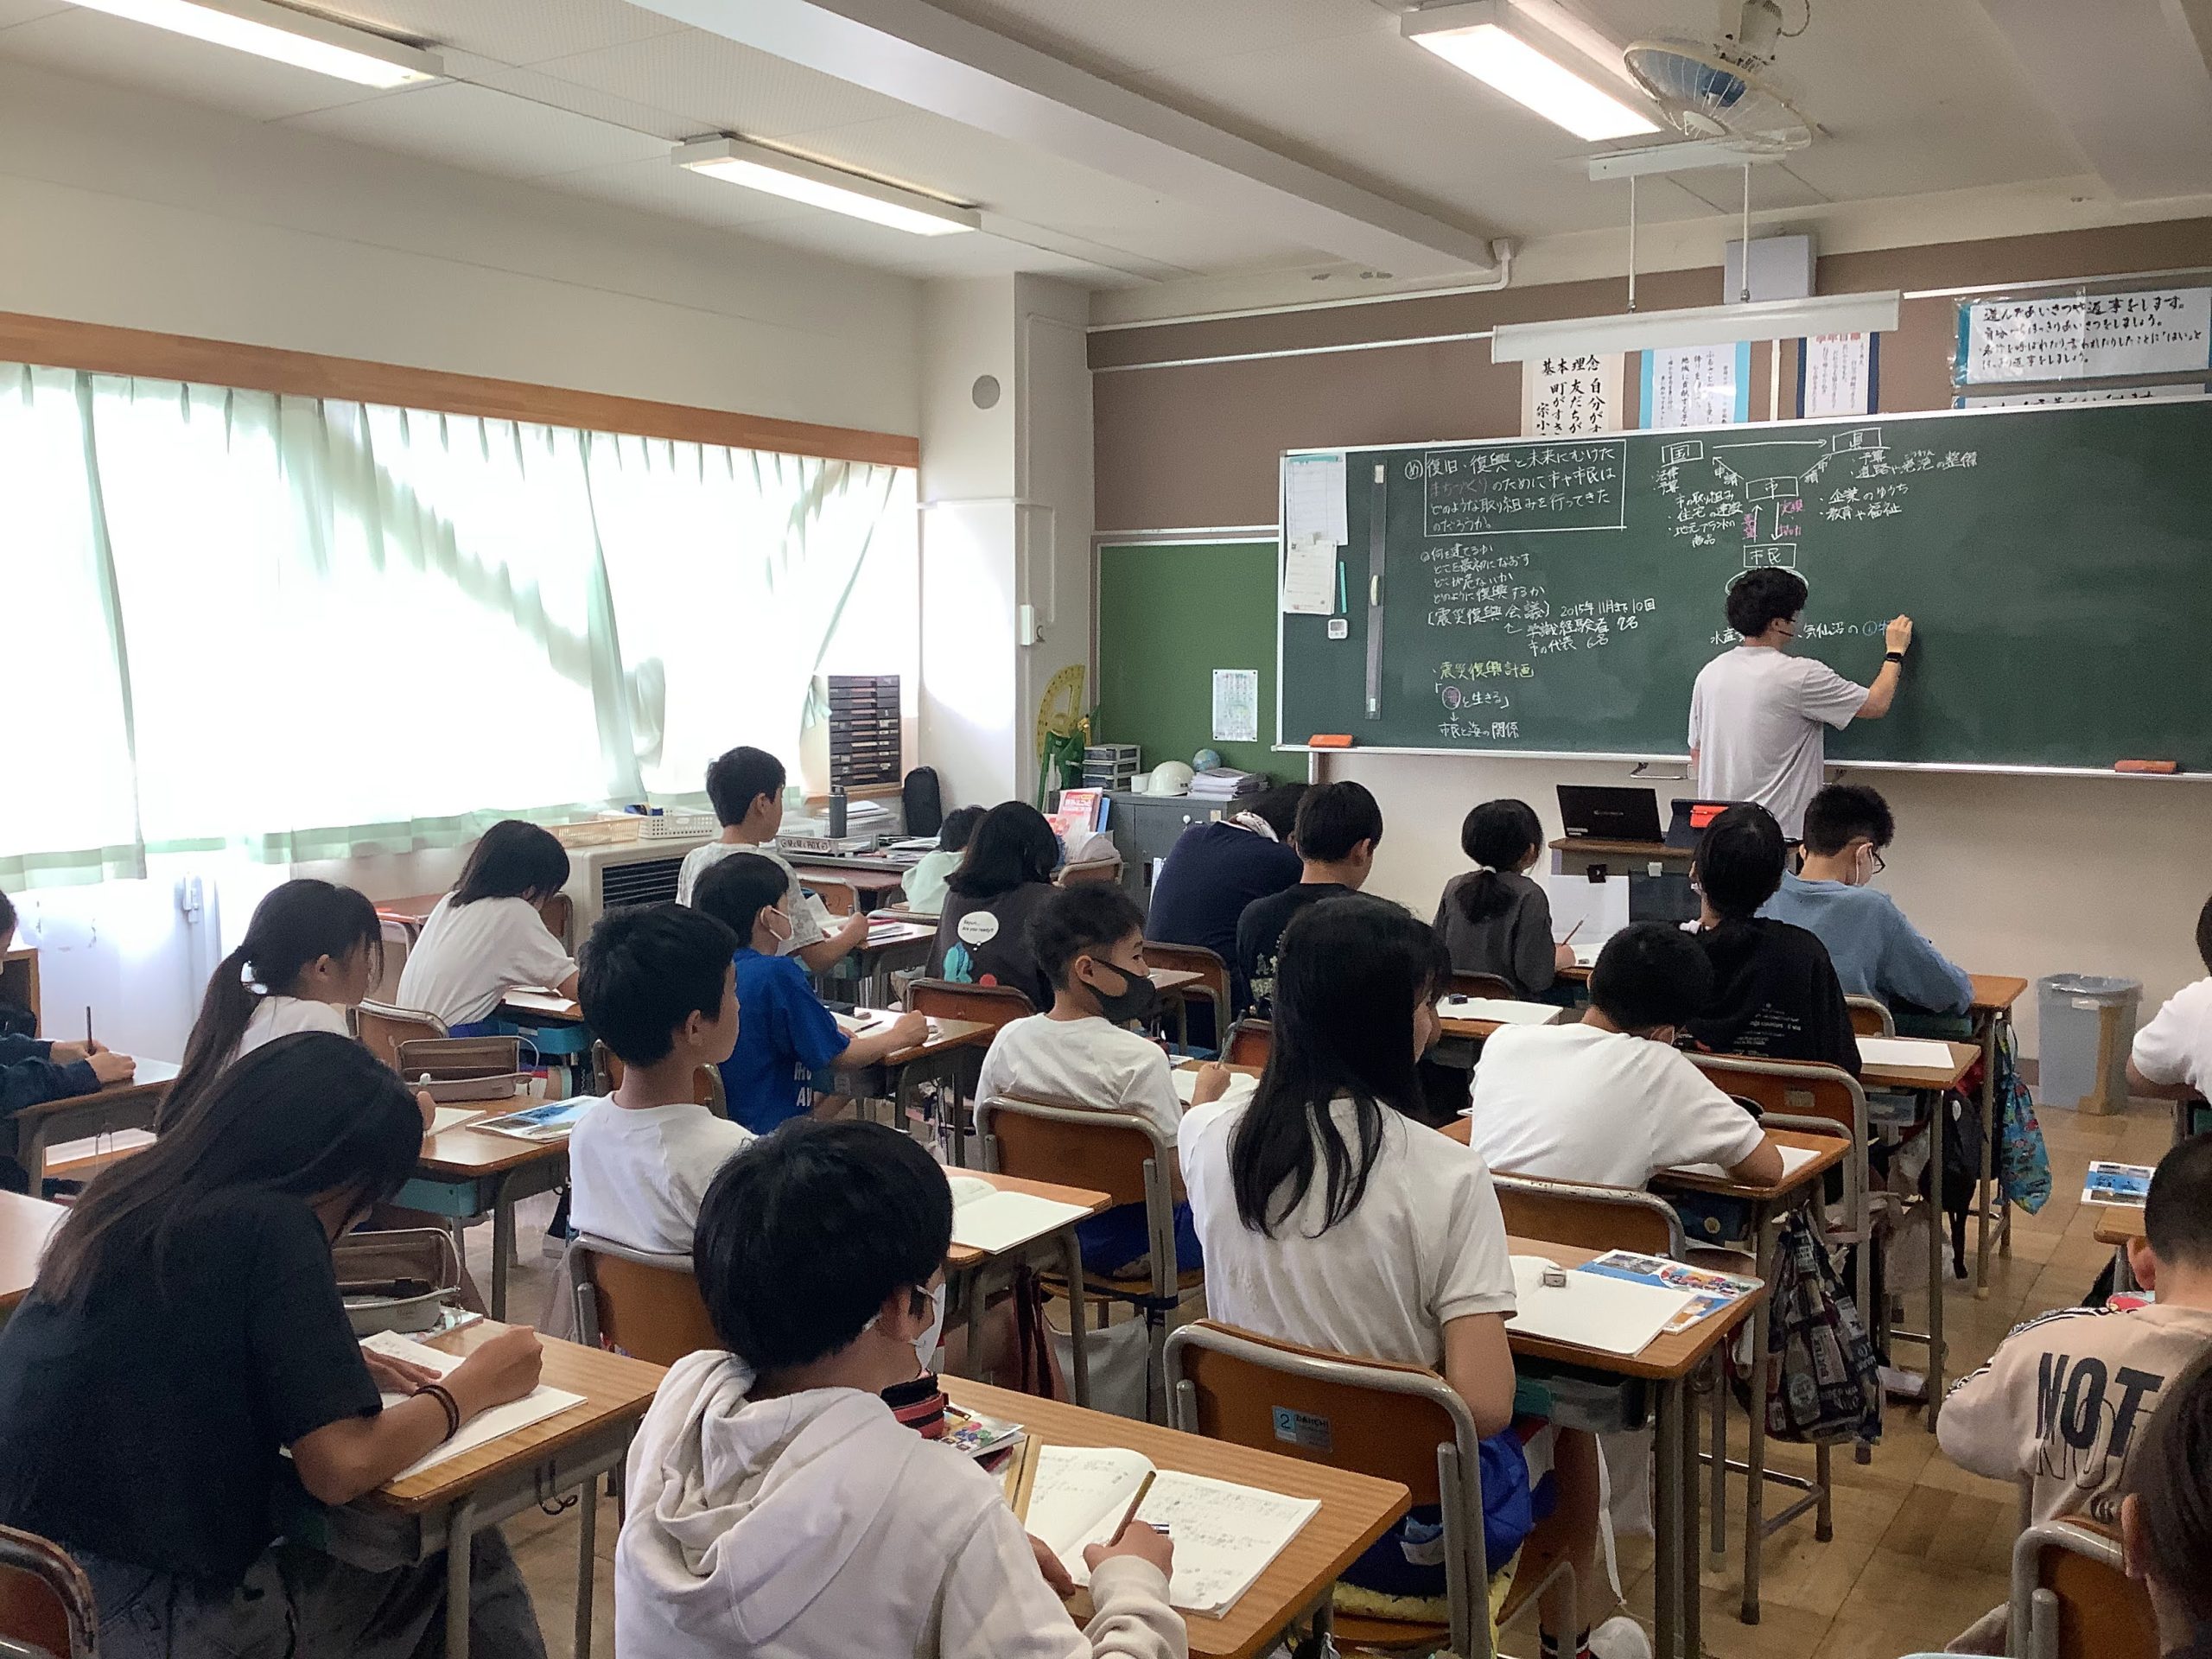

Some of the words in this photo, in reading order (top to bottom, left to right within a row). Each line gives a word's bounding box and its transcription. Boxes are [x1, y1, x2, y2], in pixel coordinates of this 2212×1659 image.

[1542, 354, 1600, 376] 基本理念
[1750, 547, 1781, 566] 市民
[2036, 1352, 2164, 1458] NOT
[1280, 1414, 1291, 1430] 2
